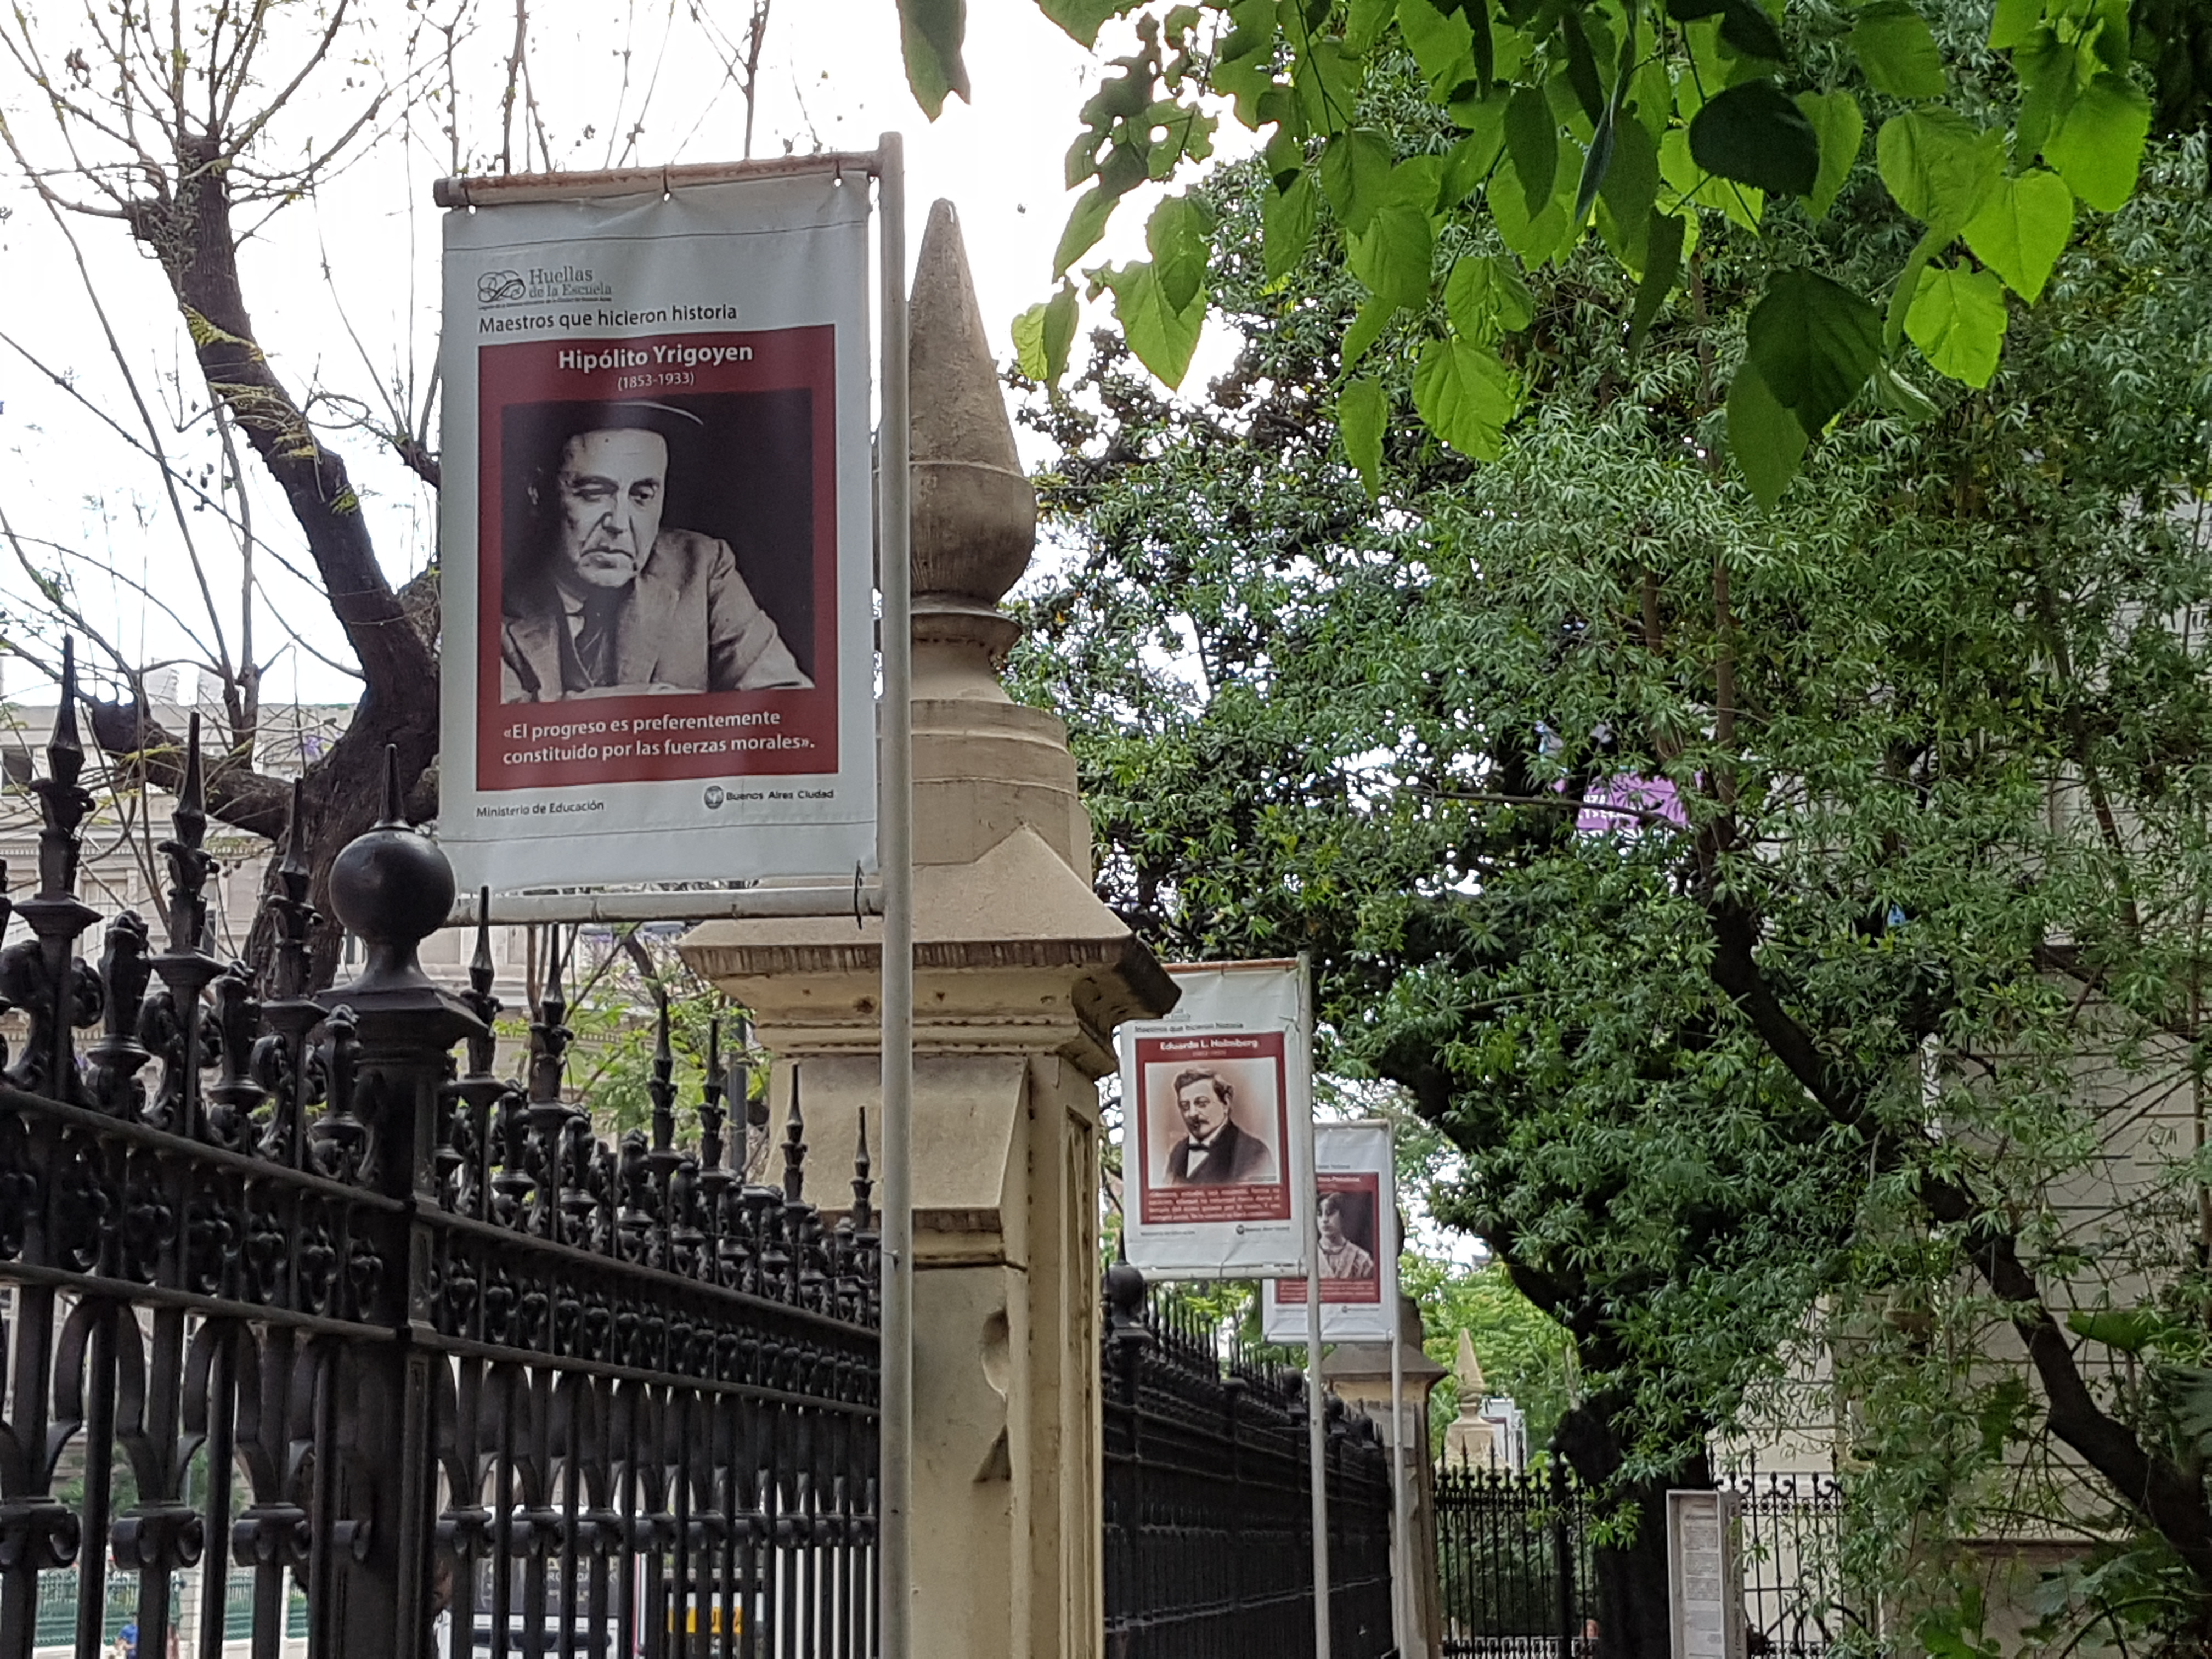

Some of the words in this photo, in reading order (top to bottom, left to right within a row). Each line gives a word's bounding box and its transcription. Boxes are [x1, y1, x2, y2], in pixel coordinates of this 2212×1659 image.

[529, 266, 593, 285] Huellas
[529, 285, 544, 298] de
[546, 284, 558, 297] la
[562, 282, 612, 296] Escuela
[479, 315, 554, 334] Maestros
[559, 313, 592, 330] que
[598, 309, 667, 326] hicieron
[672, 304, 737, 321] historia
[558, 348, 648, 374] Hipólito
[652, 343, 753, 367] Yrigoyen
[617, 371, 695, 391] (1853-1933)
[504, 723, 527, 739] «El
[532, 721, 606, 741] progreso
[610, 719, 629, 731] es
[633, 711, 781, 735] preferentemente
[503, 743, 598, 765] constituido
[602, 744, 632, 761] por
[636, 740, 660, 755] las
[664, 739, 726, 755] fuerzas
[731, 733, 815, 751] morales».
[726, 792, 764, 800] Buenos
[769, 791, 794, 800] Aires
[798, 789, 834, 799] Ciudad
[476, 804, 530, 817] Ministerio
[532, 803, 546, 814] de
[549, 800, 605, 813] Educación
